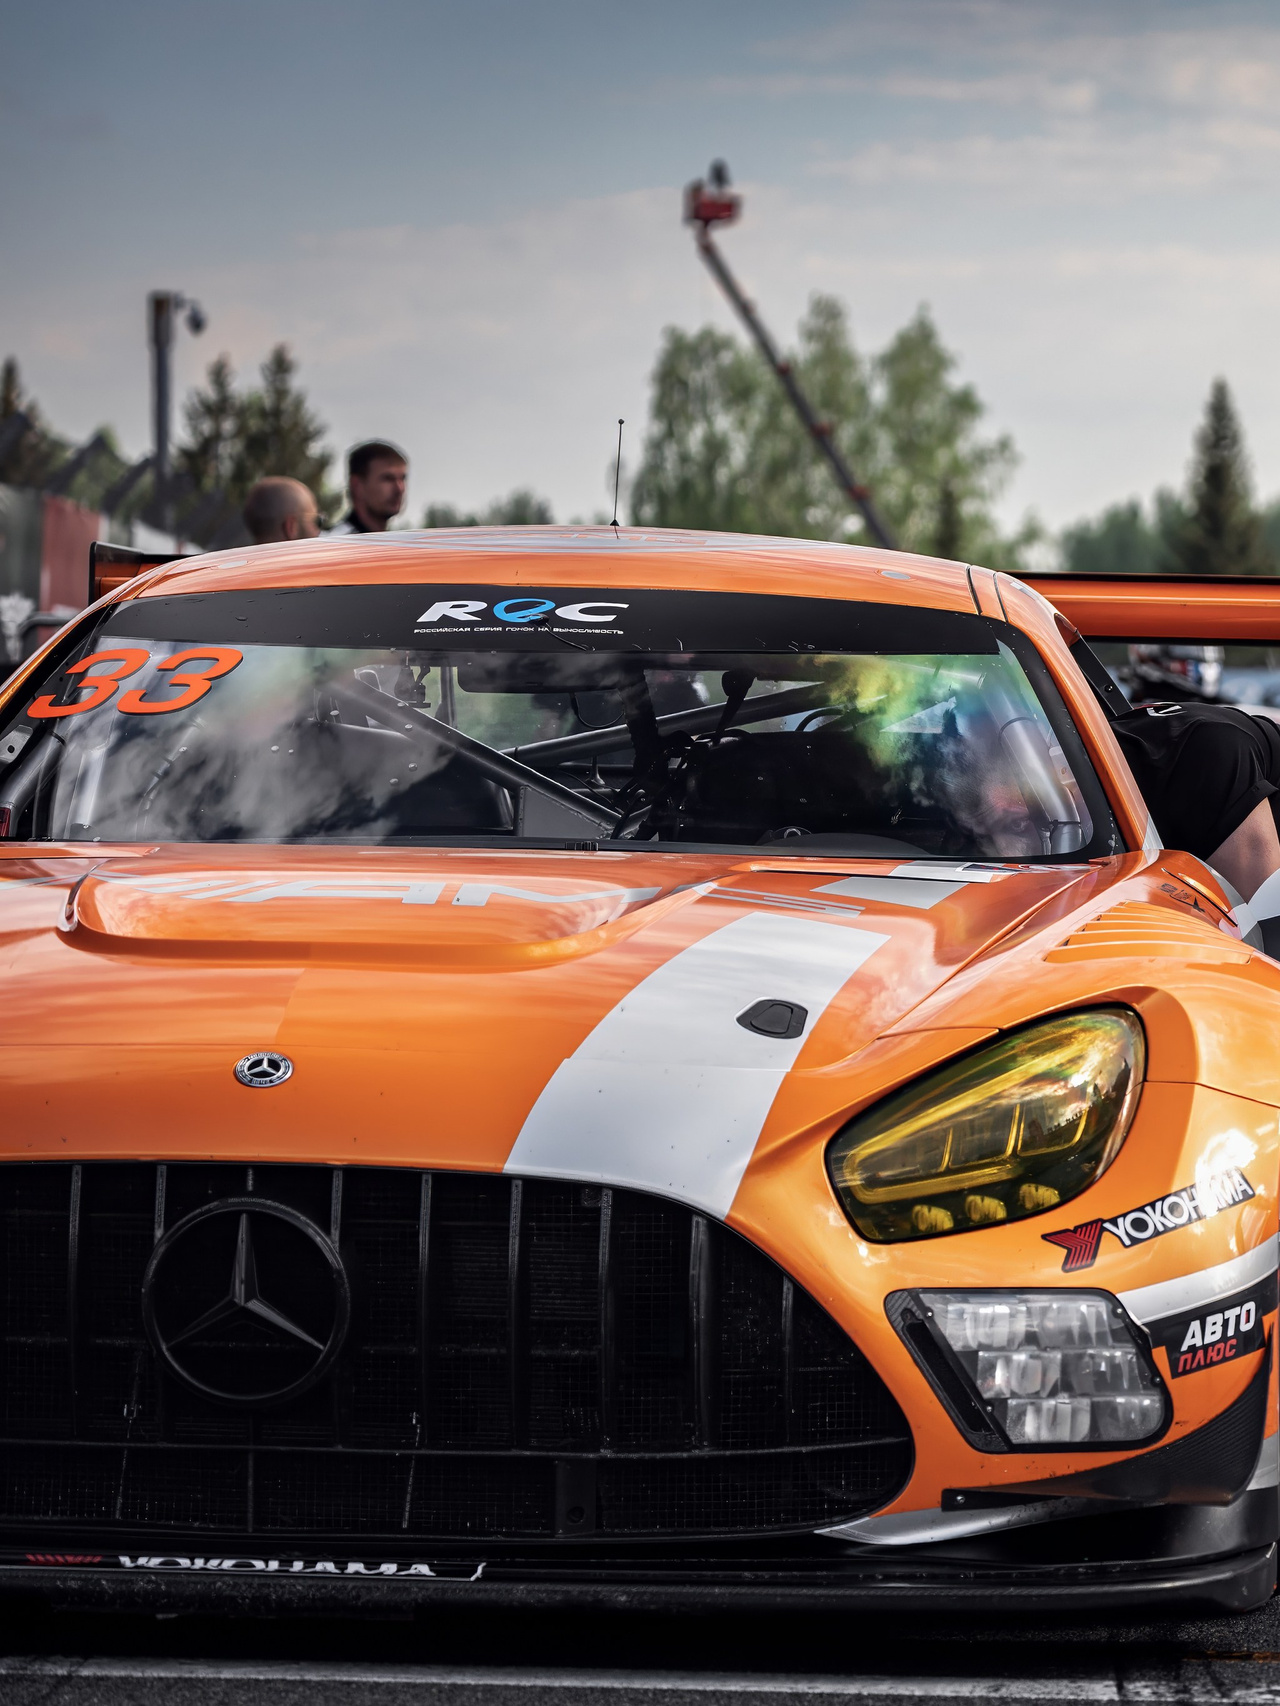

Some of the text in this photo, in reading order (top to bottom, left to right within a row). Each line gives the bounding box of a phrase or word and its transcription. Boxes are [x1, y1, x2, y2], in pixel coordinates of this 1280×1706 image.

[414, 625, 471, 633] РОССИЙСКАЯ
[27, 647, 243, 718] 33
[1102, 1167, 1253, 1246] YOKOHMA
[1180, 1301, 1256, 1352] АВТО
[1178, 1338, 1237, 1373] ПЛЮС
